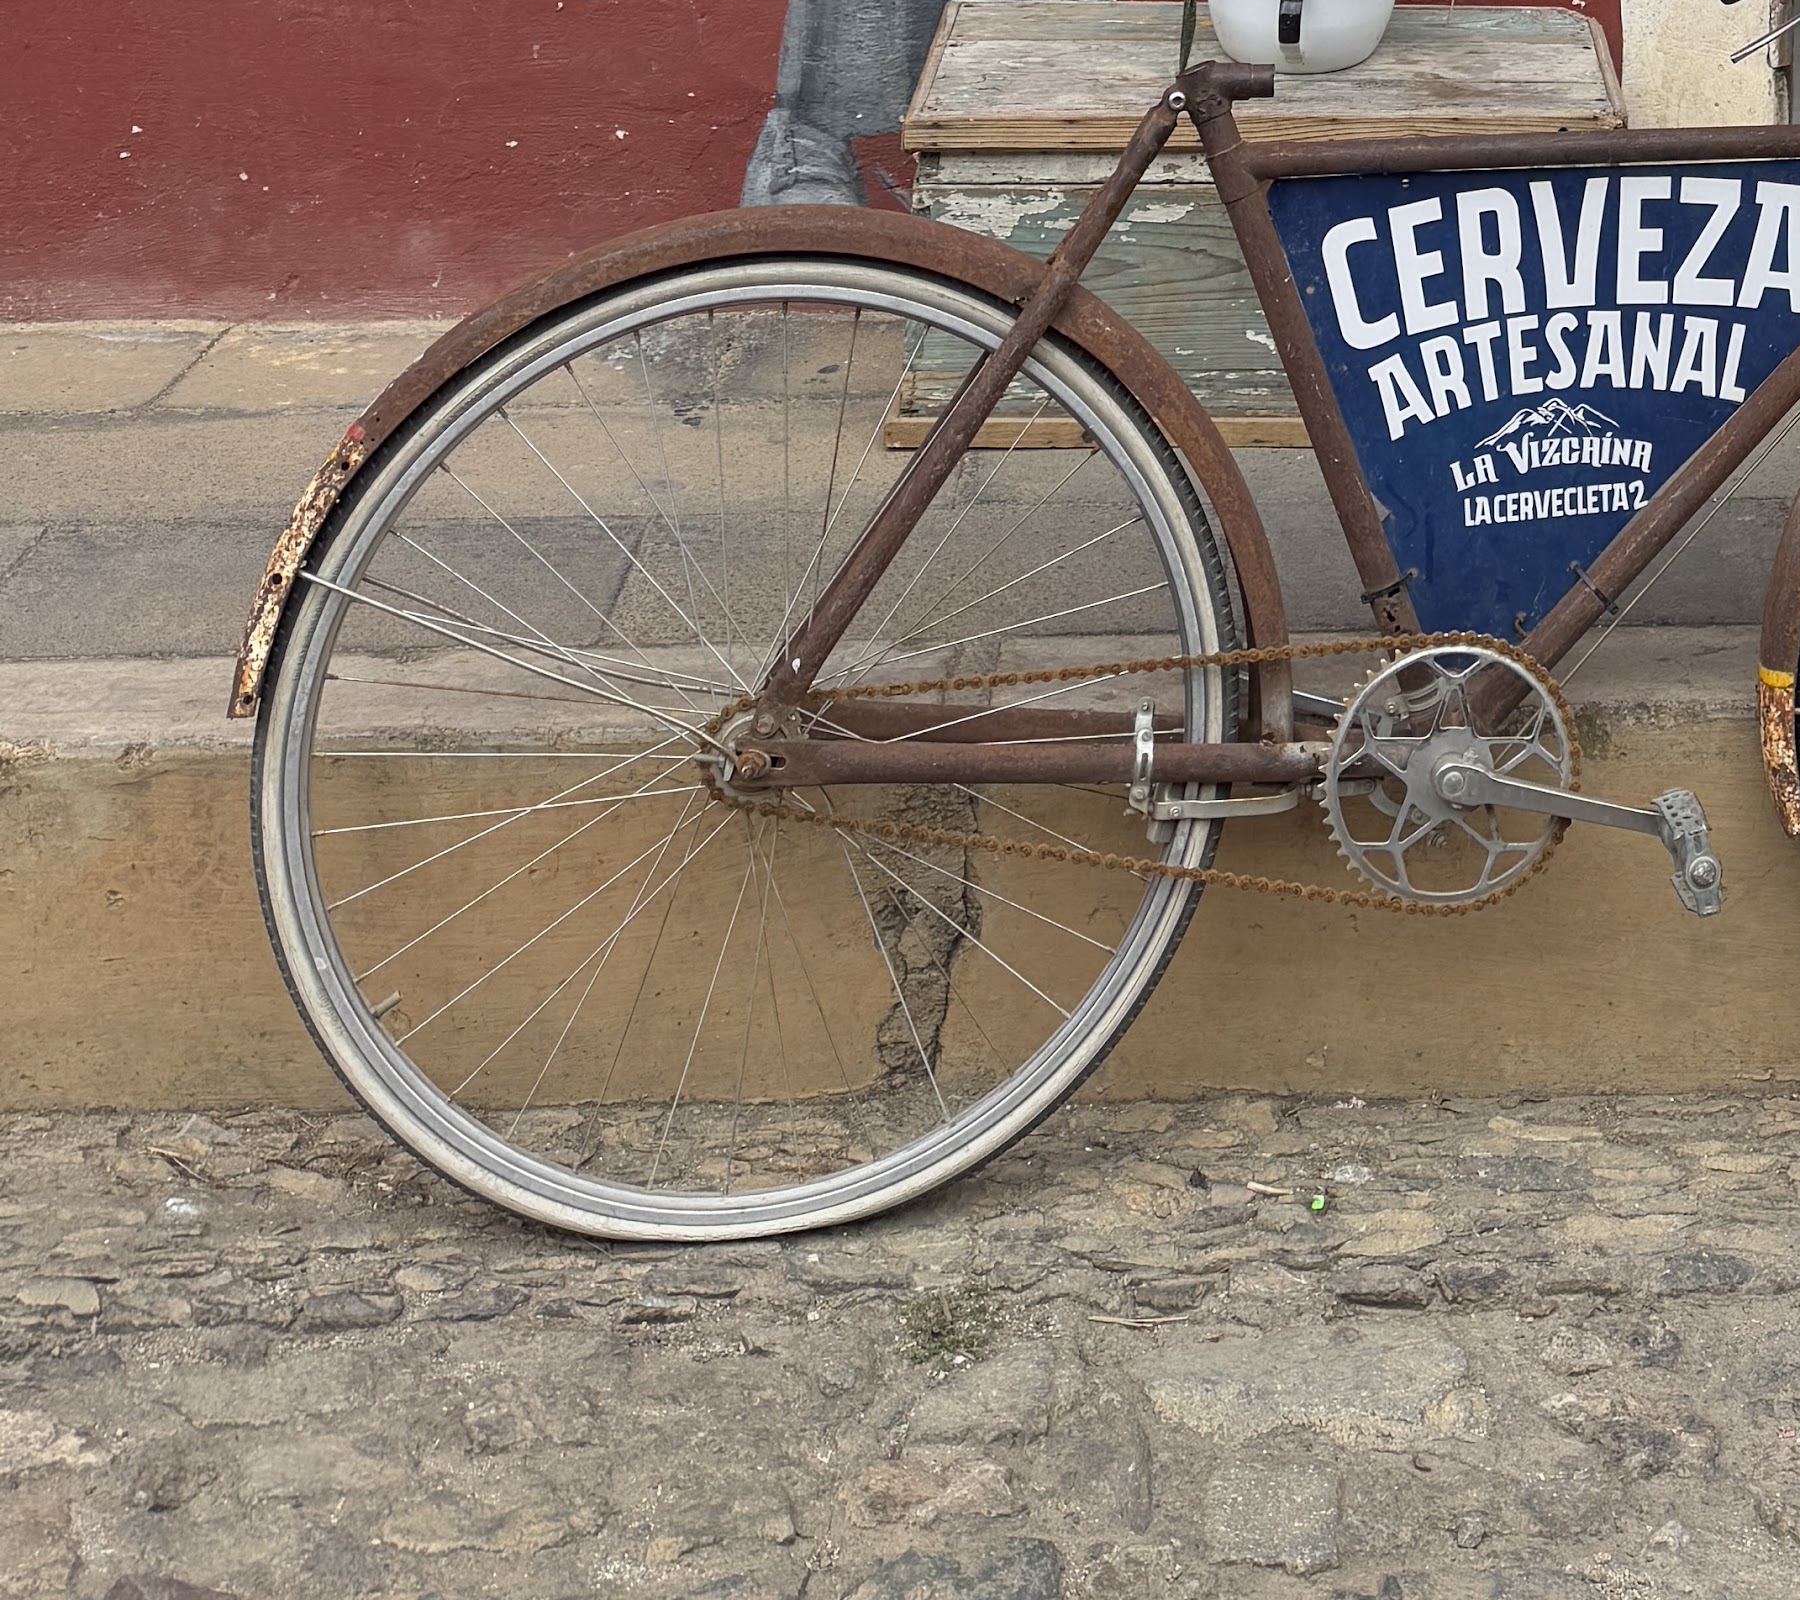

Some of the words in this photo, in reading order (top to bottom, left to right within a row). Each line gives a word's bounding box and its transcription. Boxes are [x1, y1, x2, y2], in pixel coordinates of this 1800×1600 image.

[1368, 310, 1748, 441] ARTESANAL
[1450, 453, 1500, 492] LA
[1496, 431, 1653, 475] VIZCAÍNA
